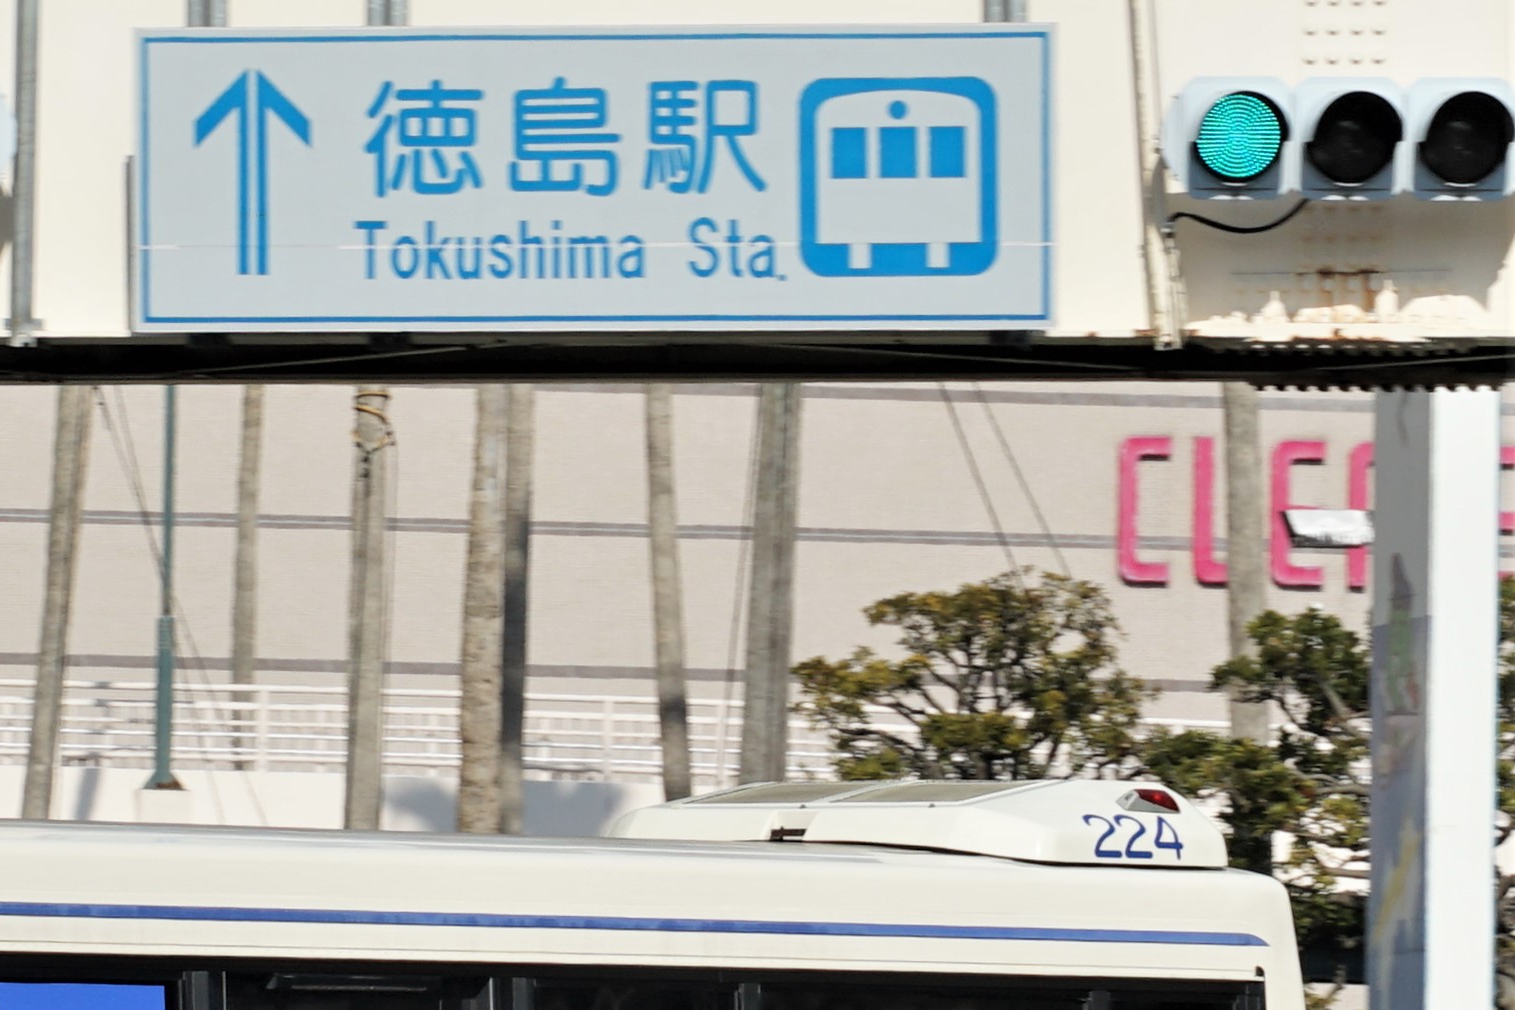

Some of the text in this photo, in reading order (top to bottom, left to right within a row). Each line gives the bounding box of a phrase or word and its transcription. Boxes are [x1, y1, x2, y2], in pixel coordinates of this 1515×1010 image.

[365, 76, 768, 197] 徳島駅
[354, 218, 789, 282] Tokushima Sta.
[1082, 814, 1184, 861] 224
